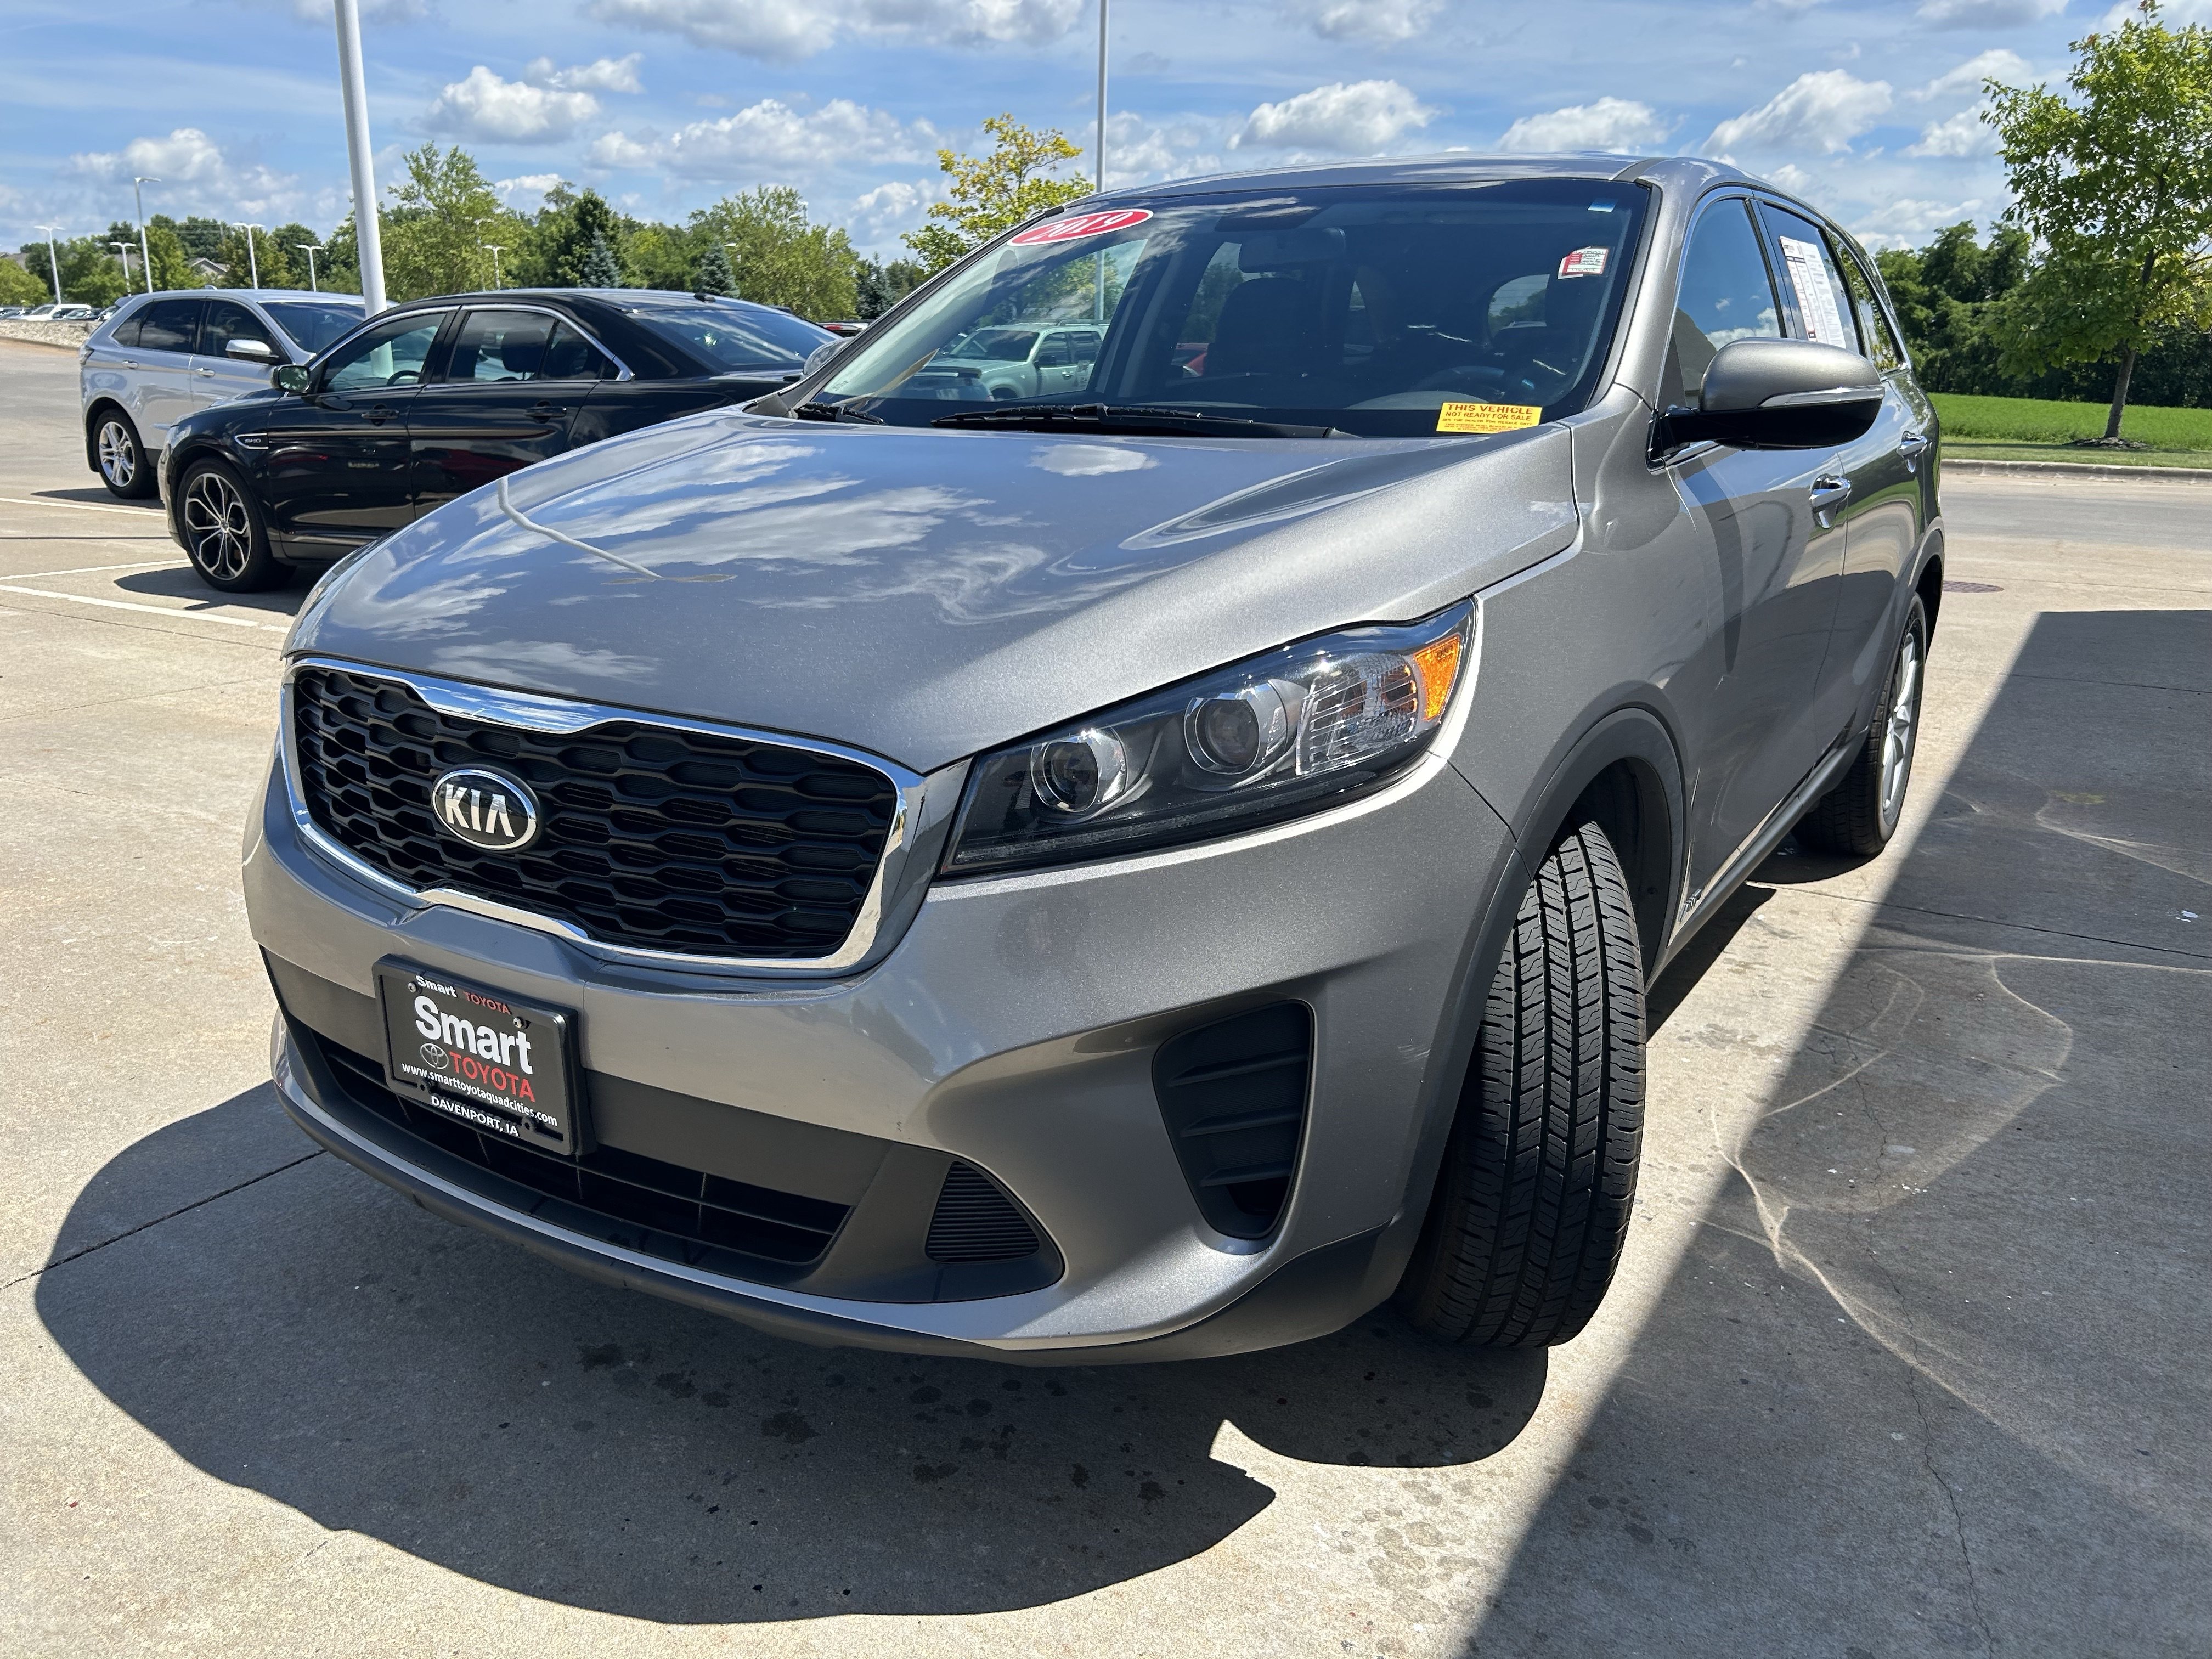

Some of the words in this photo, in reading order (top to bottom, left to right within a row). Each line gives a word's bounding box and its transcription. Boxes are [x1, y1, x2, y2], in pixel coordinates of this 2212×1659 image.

[1023, 212, 1133, 242] 2019
[1480, 405, 1533, 414] VEHICLE
[445, 783, 516, 838] KIA
[415, 975, 458, 997] Smart
[462, 991, 512, 1015] TOYOTA
[414, 995, 533, 1075] Smart
[401, 1063, 558, 1127] www.smarttoyotaquadcities.com
[449, 1051, 536, 1103] TOYOTA
[431, 1096, 504, 1132] DAVENPORT,
[506, 1122, 520, 1137] IA
